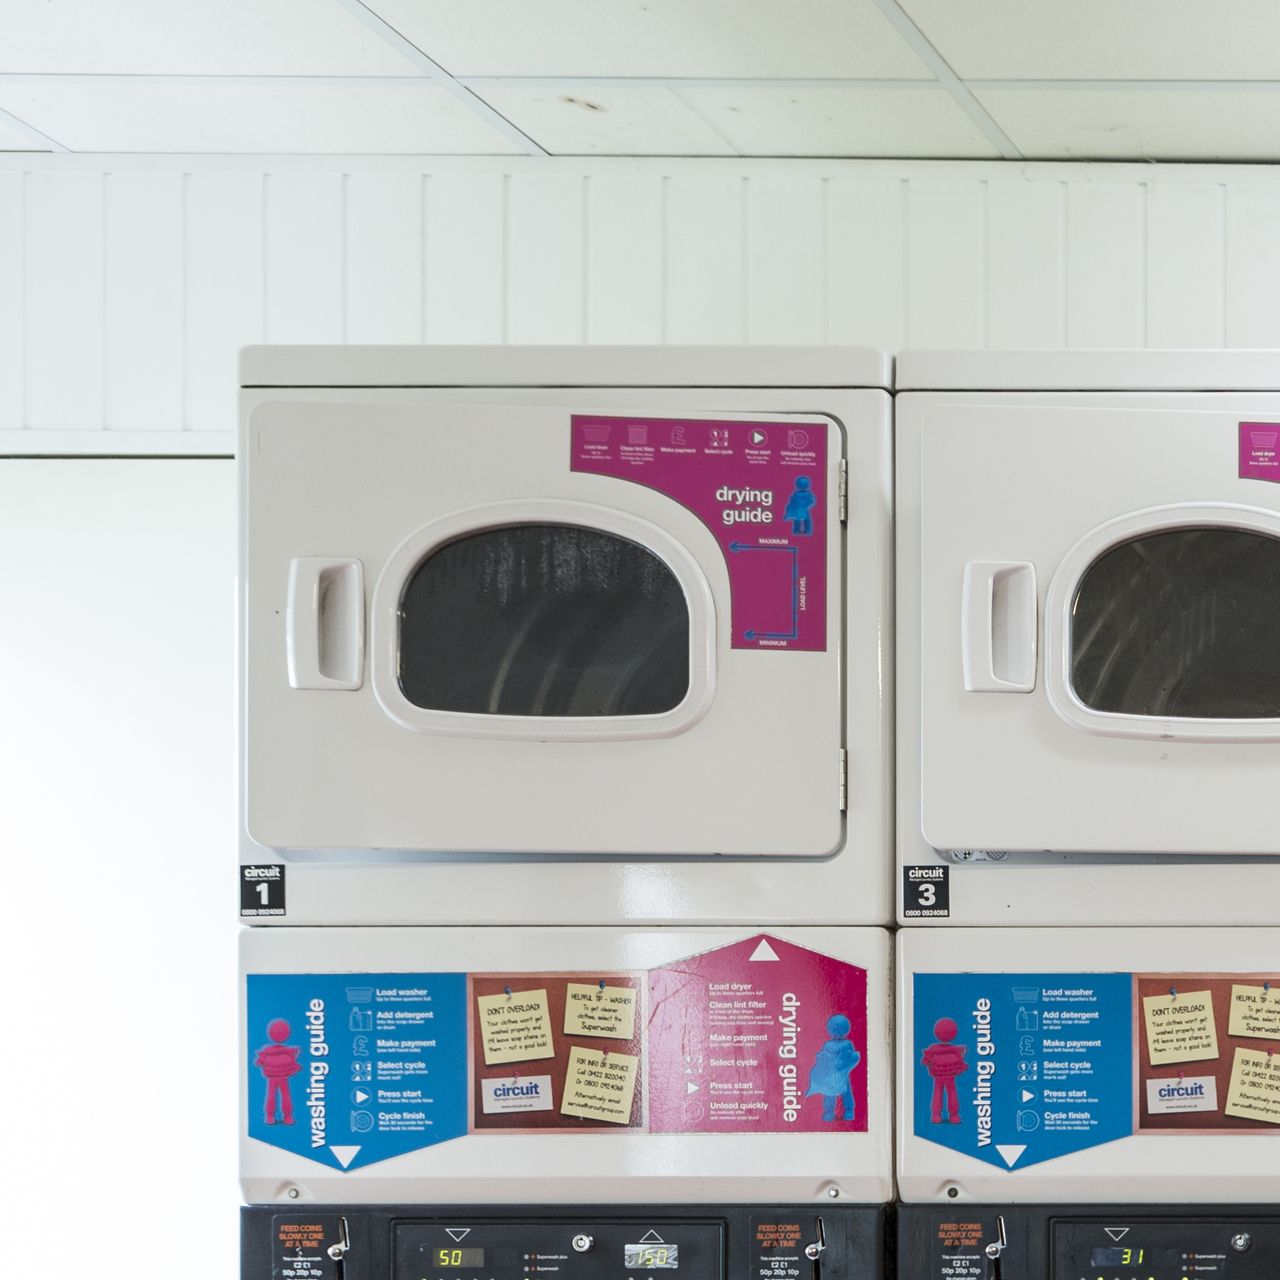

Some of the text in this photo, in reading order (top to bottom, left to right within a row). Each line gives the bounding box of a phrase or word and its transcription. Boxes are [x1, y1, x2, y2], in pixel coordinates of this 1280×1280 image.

[715, 487, 773, 504] drying
[722, 508, 773, 524] guide
[245, 867, 281, 878] circuit
[909, 868, 944, 878] circuit
[256, 883, 268, 905] 1
[918, 884, 936, 906] 3
[782, 992, 800, 1123] drying guide
[309, 999, 329, 1148] washing guide
[973, 998, 995, 1147] washing guide
[1070, 1062, 1091, 1070] cycle
[493, 1080, 540, 1099] circuit
[1159, 1083, 1204, 1097] circuit
[1044, 1112, 1067, 1120] Cycle
[438, 1250, 462, 1265] 50
[1122, 1250, 1144, 1264] 31
